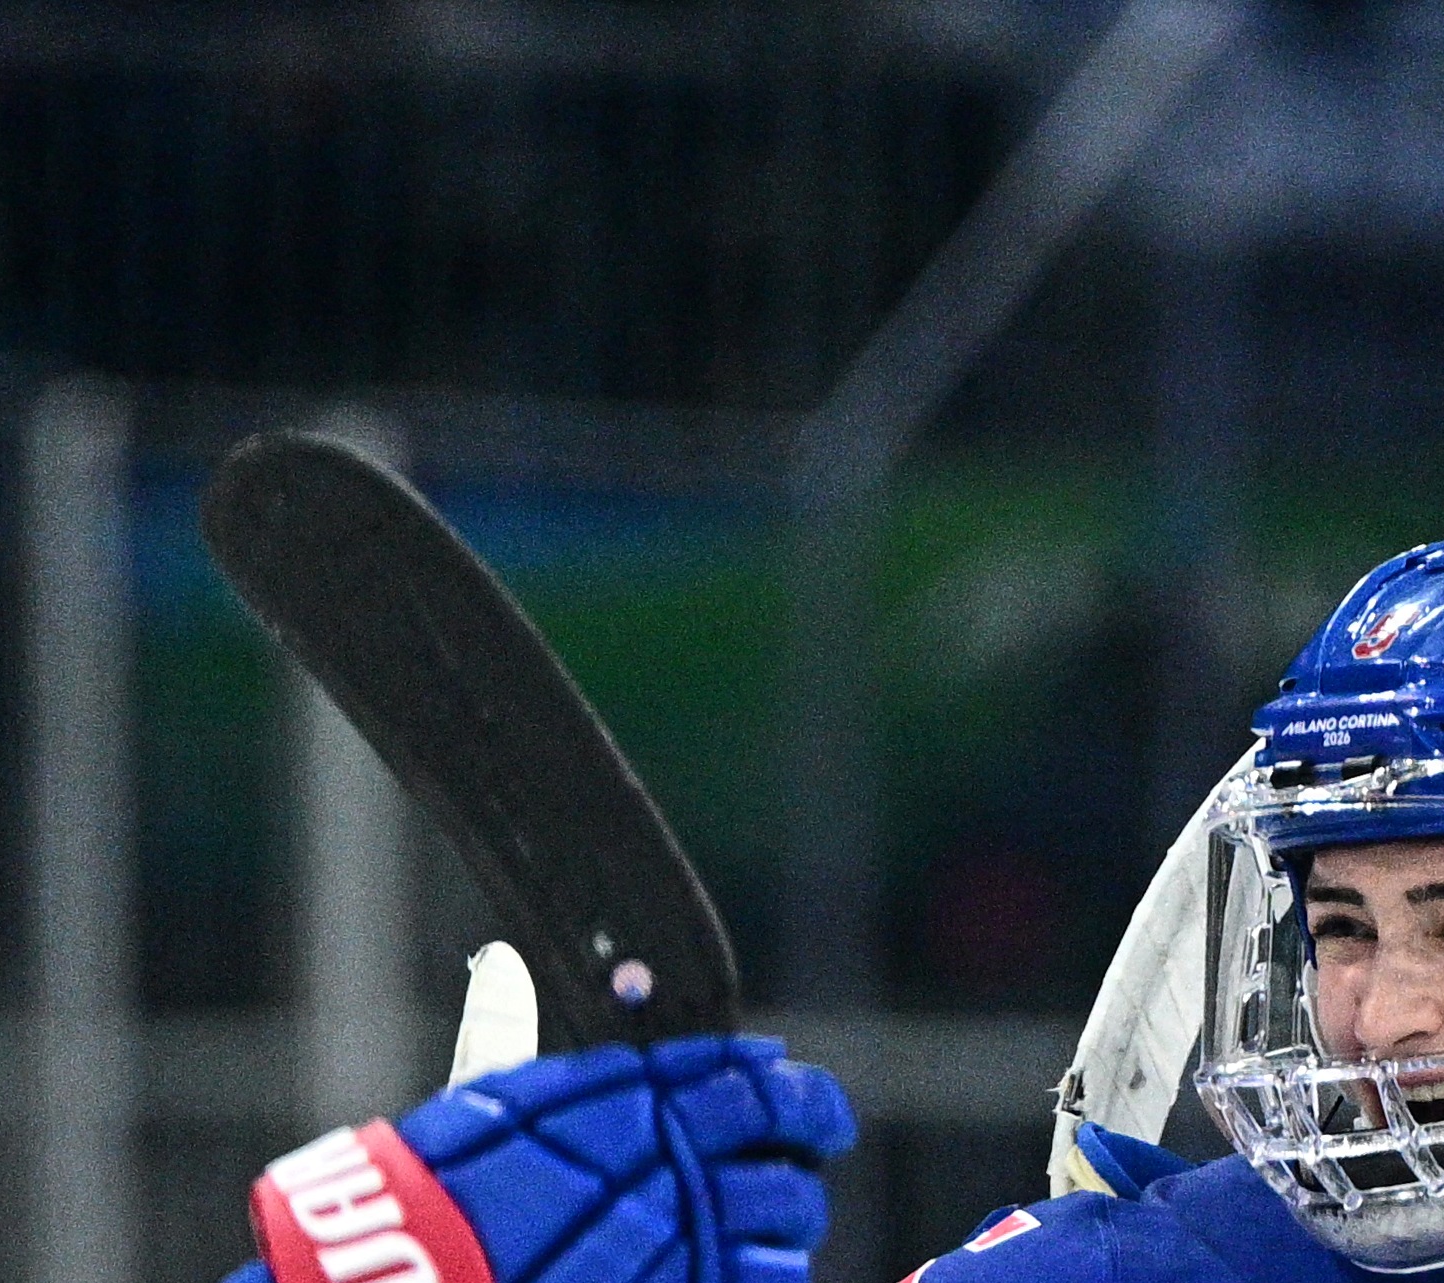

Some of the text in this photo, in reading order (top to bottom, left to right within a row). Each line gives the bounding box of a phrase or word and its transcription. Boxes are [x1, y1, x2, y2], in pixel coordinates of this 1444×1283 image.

[1281, 712, 1400, 737] MILANO CORTINA
[1322, 731, 1352, 747] 2026
